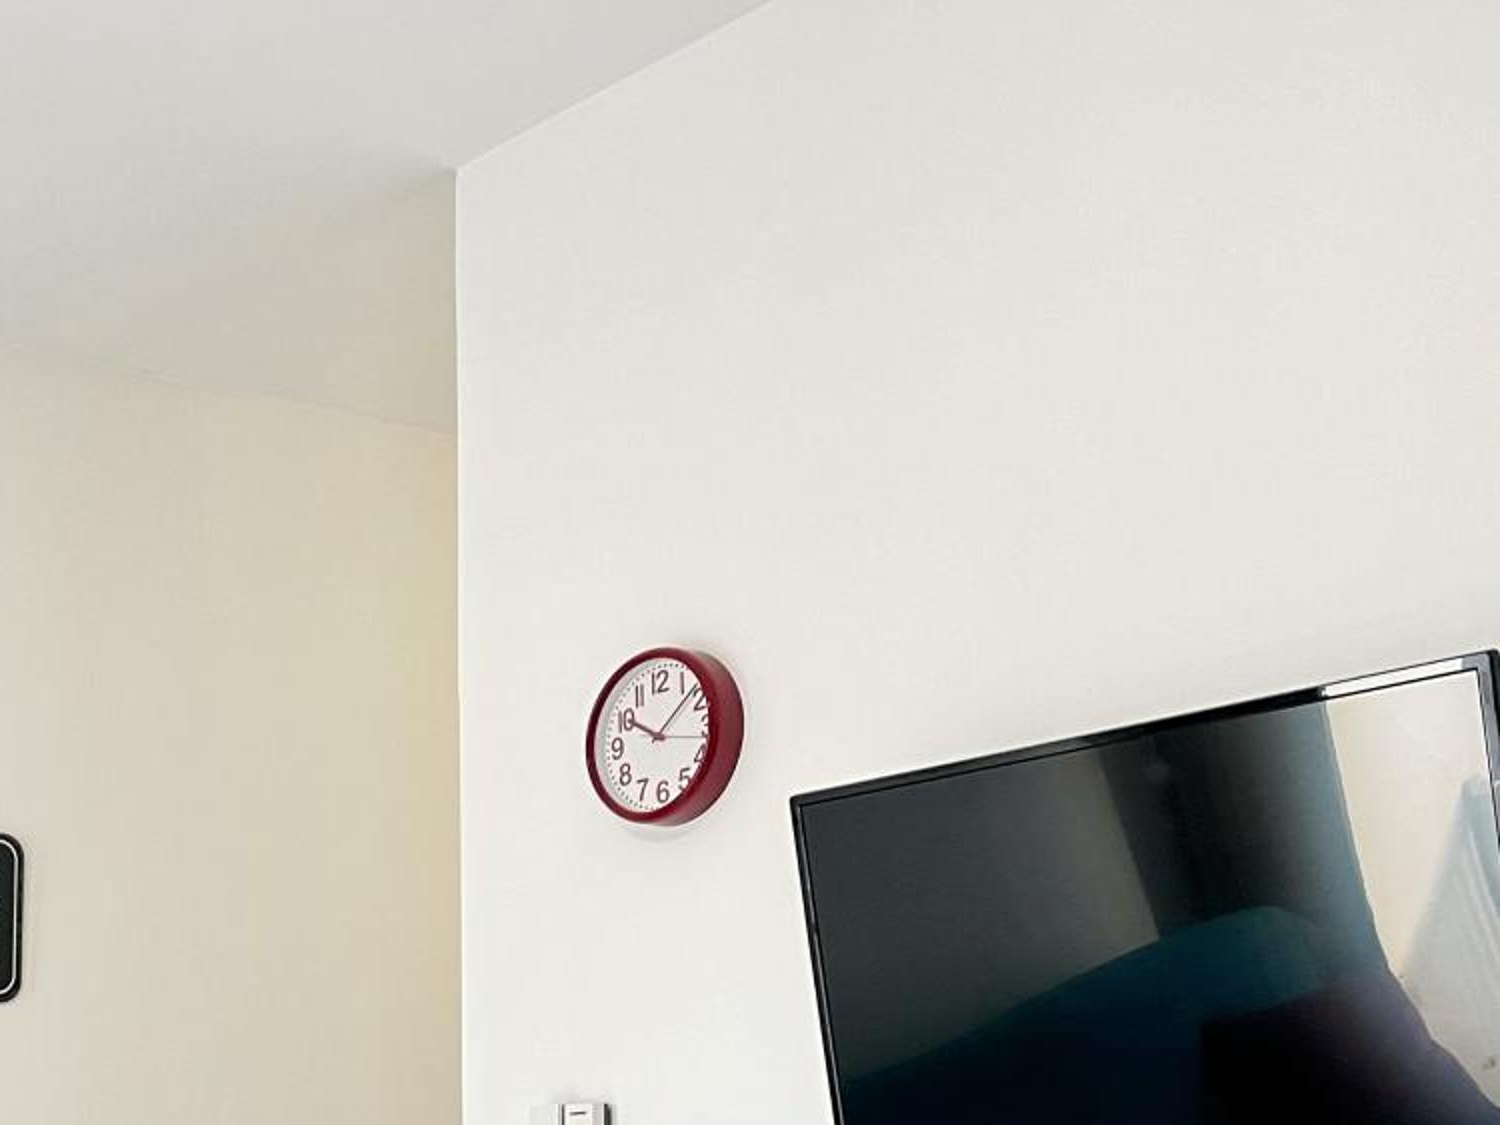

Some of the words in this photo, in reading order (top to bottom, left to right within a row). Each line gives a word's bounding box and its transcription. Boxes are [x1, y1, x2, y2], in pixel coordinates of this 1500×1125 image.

[651, 669, 670, 696] 12
[679, 671, 685, 695] 1
[635, 684, 645, 708] 11
[618, 708, 635, 733] 10
[611, 737, 624, 761] 9
[620, 763, 632, 786] 8
[678, 767, 691, 791] 5
[637, 778, 649, 801] 7
[656, 780, 670, 804] 6
